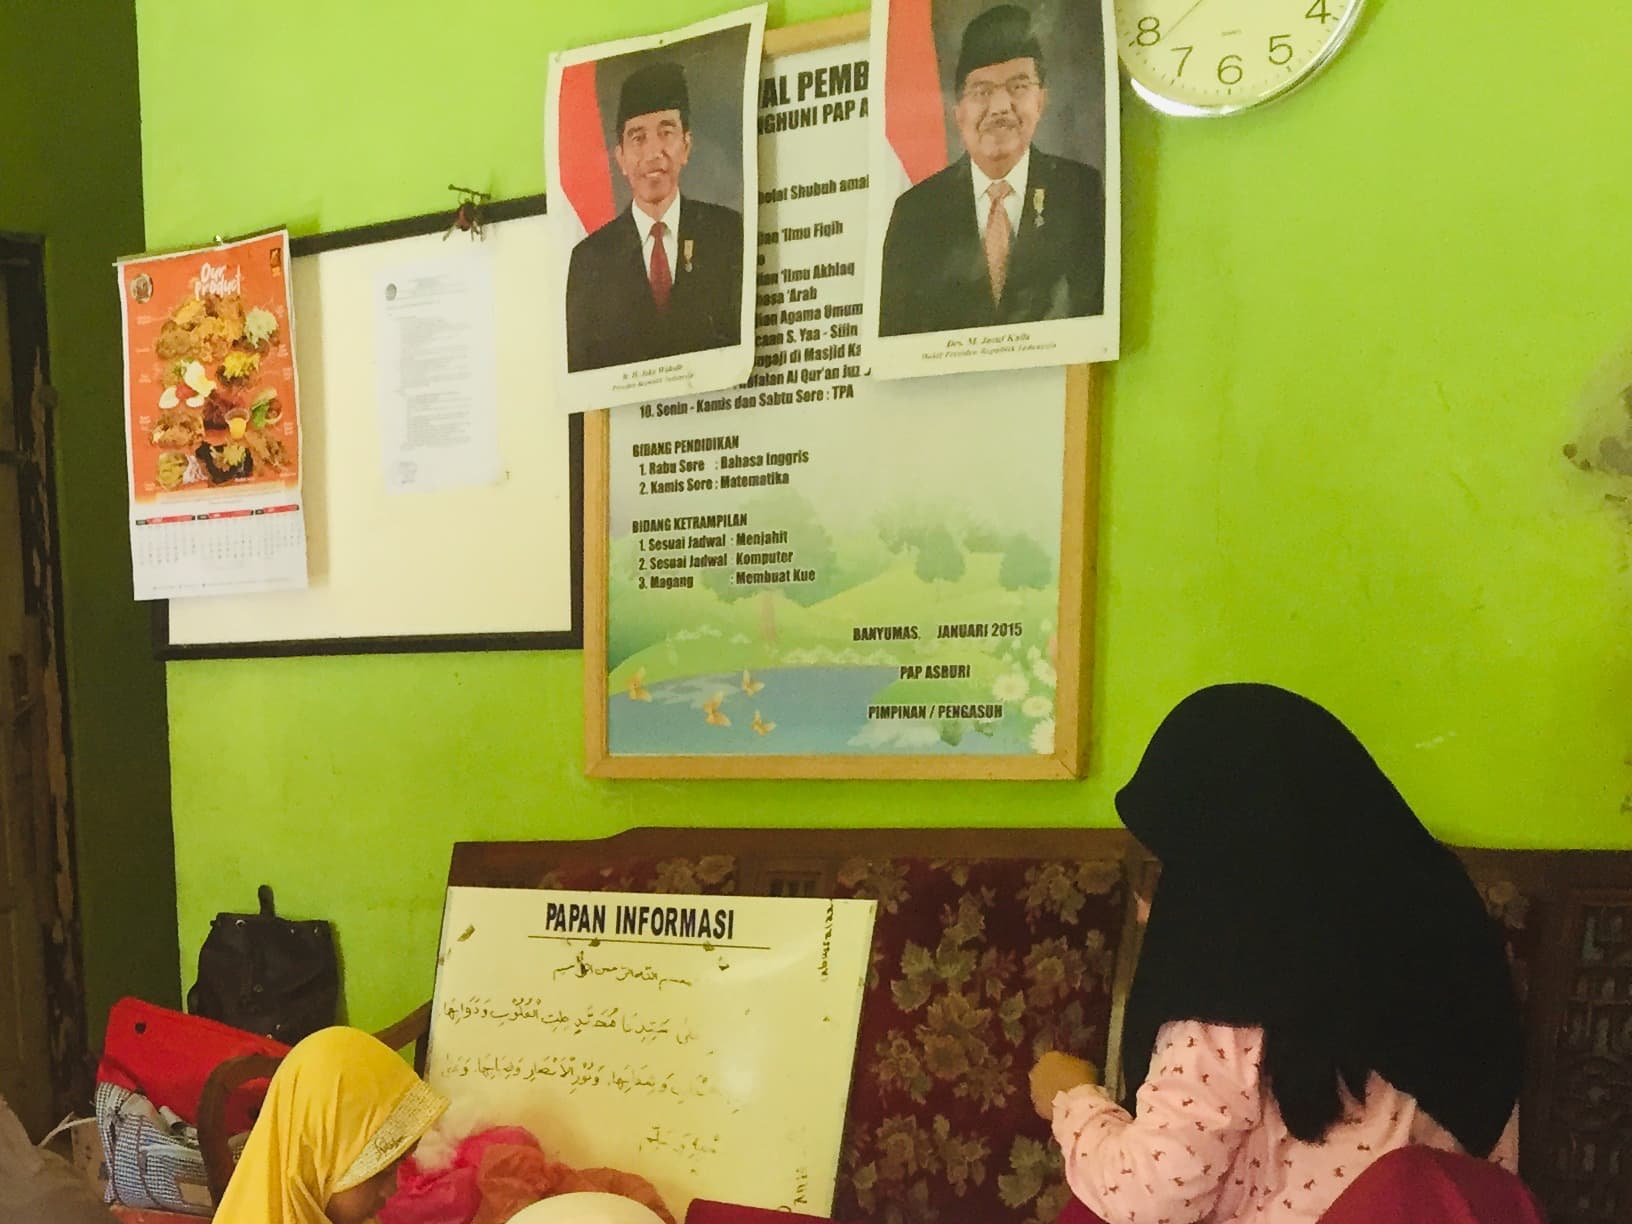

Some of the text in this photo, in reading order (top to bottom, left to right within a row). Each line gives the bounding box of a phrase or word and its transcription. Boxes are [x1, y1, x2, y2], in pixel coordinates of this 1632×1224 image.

[1304, 0, 1332, 24] 4
[1135, 16, 1161, 47] 8
[1268, 34, 1293, 65] 5
[1170, 46, 1193, 77] 7
[1217, 54, 1243, 85] 6
[759, 75, 790, 109] AL
[823, 99, 855, 124] PAP
[790, 179, 837, 200] Shubuh
[200, 262, 226, 282] Our
[813, 261, 855, 280] Akhlaq
[194, 265, 241, 301] product
[781, 306, 822, 325] Agama
[824, 303, 864, 319] Umum
[800, 327, 821, 342] Yaa
[790, 350, 801, 363] di
[804, 343, 845, 362] Masjid
[639, 404, 654, 419] 10.
[656, 401, 688, 418] Senin
[696, 396, 732, 413] Kamis
[734, 395, 756, 410] dan
[759, 391, 793, 407] Sabtu
[796, 388, 824, 403] Sore
[832, 384, 854, 400] TPA
[632, 435, 740, 457] BIDANG PENDIDIKAN
[649, 461, 676, 475] Rabu
[679, 459, 705, 473] Sore
[720, 454, 763, 470] Bahasa
[766, 449, 809, 467] Inggris
[650, 480, 685, 494] Kamis
[687, 477, 713, 492] Sore
[720, 471, 790, 489] Matematika
[632, 512, 748, 533] BIDANG KETRAMPILAN
[649, 536, 685, 551] Sesuai
[688, 534, 726, 549] Jadwal
[736, 530, 788, 546] Menjahit
[649, 555, 686, 570] Sesuai
[689, 553, 727, 568] Jadwal
[736, 550, 793, 566] Komputer
[650, 575, 694, 589] Magang
[736, 570, 790, 585] Membuat
[793, 568, 815, 582] Kue
[937, 623, 989, 639] JANUARI
[991, 622, 1022, 637] 2015
[900, 665, 922, 680] PAP
[868, 704, 926, 719] PIMPINAN
[938, 704, 1003, 719] PENGASUH
[546, 902, 735, 940] PAPAN INFORMASI
